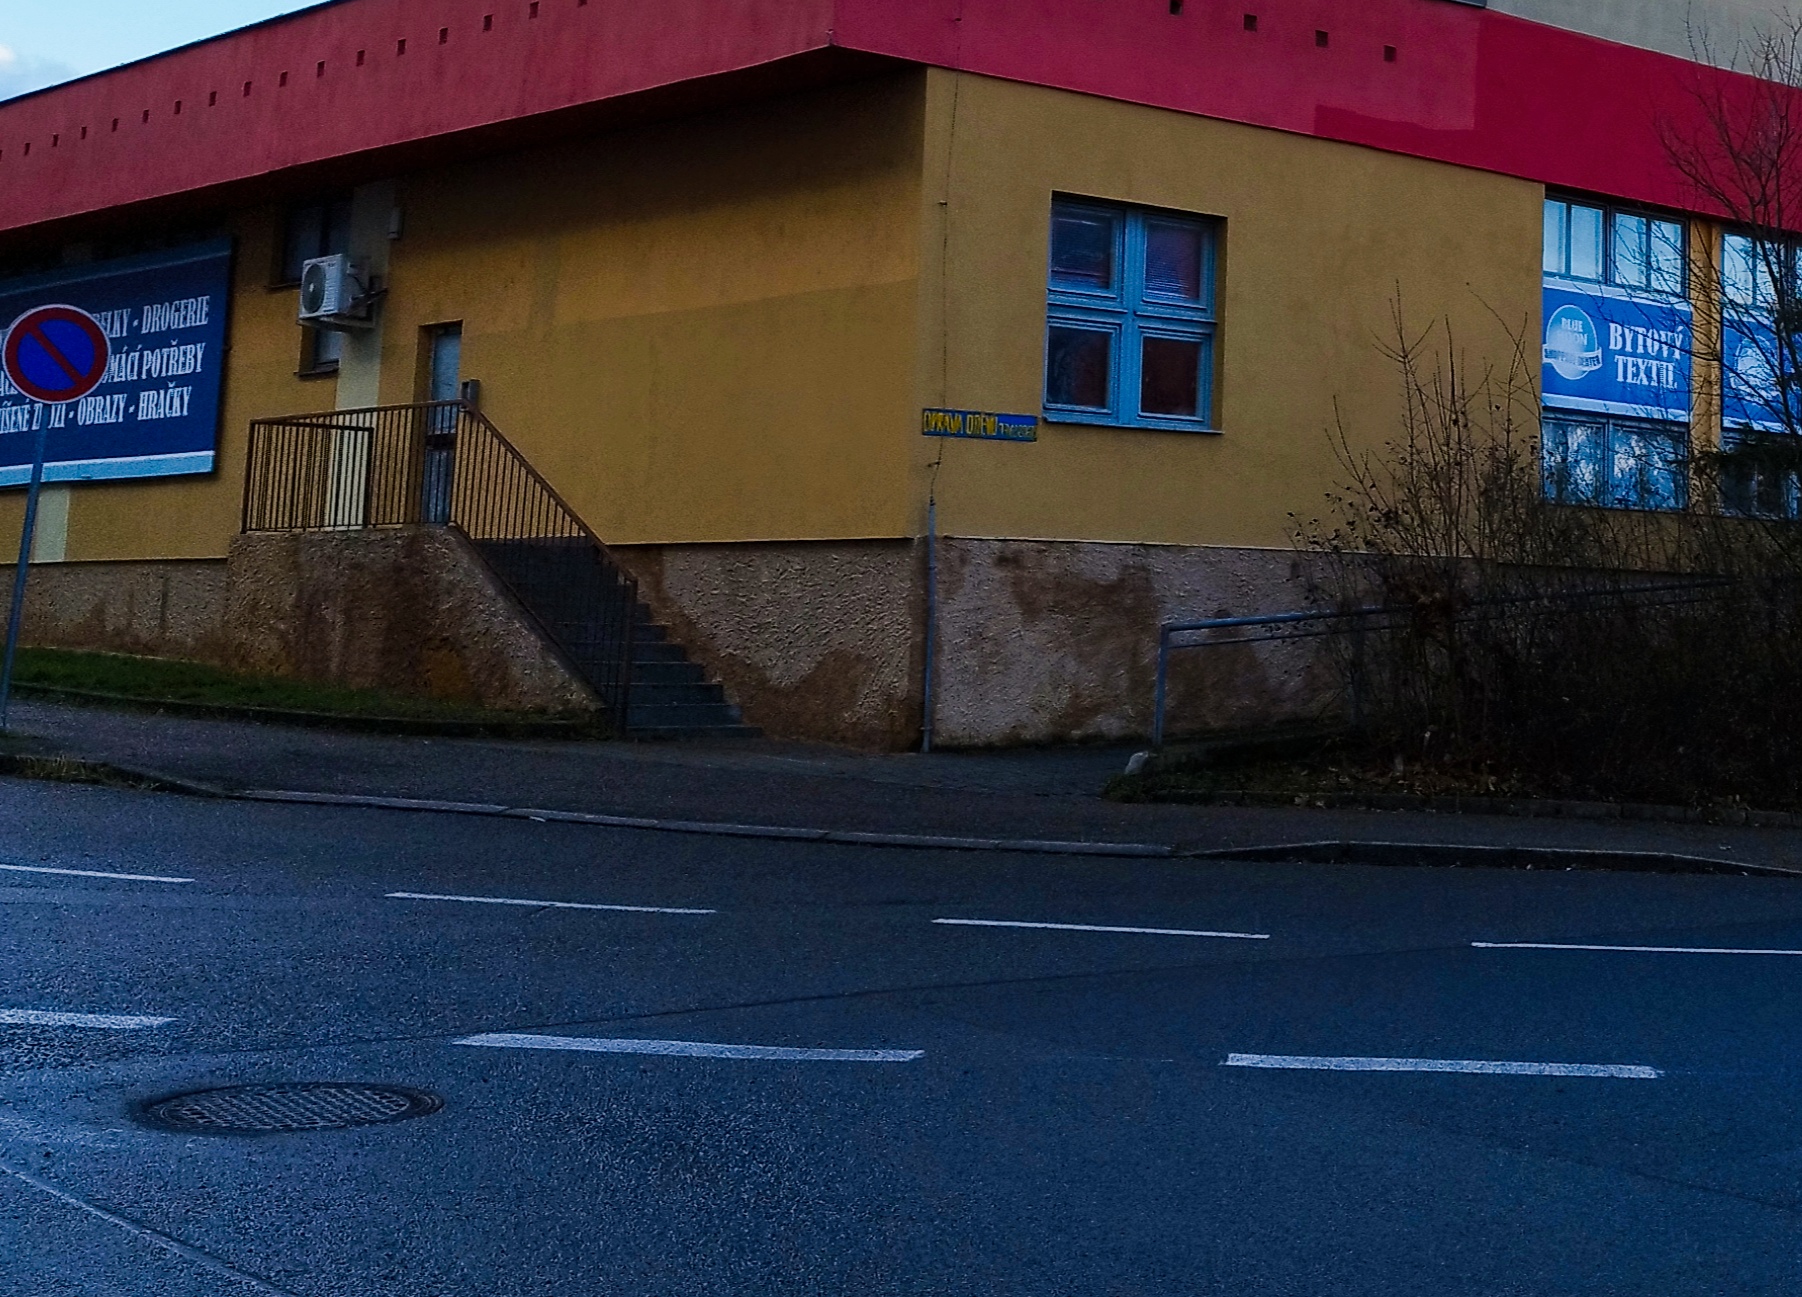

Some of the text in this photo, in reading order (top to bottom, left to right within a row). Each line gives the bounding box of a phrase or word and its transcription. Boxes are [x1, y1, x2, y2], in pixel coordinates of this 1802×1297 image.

[92, 296, 210, 338] ELKY DROGERIE
[102, 338, 206, 384] MÁCÍ POTŘEBY
[1608, 322, 1683, 361] BYTOVÝ
[1614, 354, 1678, 389] TEXTIL
[77, 393, 127, 426] OBRAZY
[137, 381, 192, 420] HRAČKY
